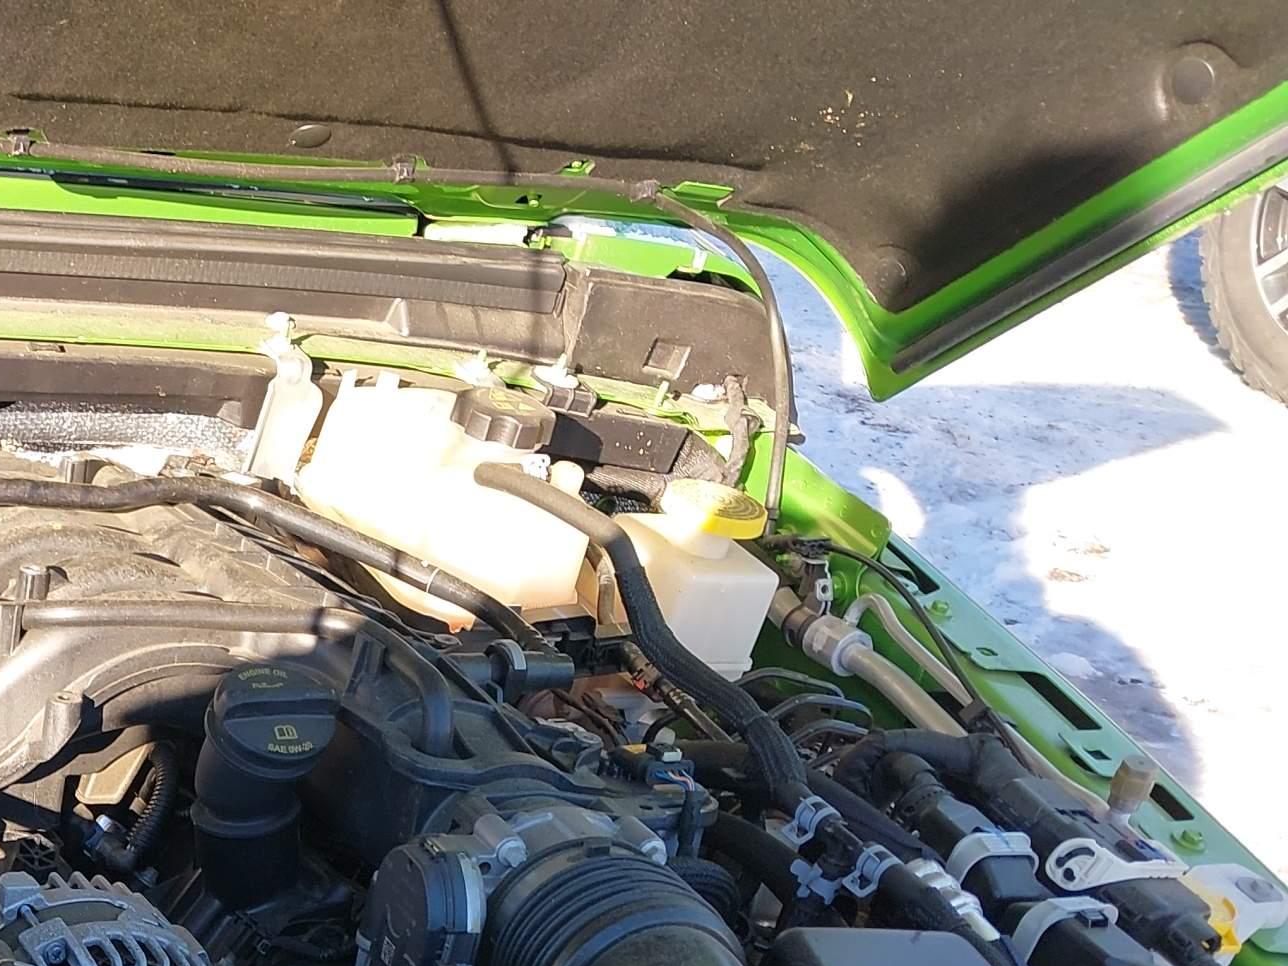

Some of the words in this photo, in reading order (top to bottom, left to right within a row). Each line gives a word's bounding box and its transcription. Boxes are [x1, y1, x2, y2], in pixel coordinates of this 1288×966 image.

[237, 667, 271, 681] ENGINE
[273, 668, 289, 680] OIL
[267, 743, 288, 754] SAE
